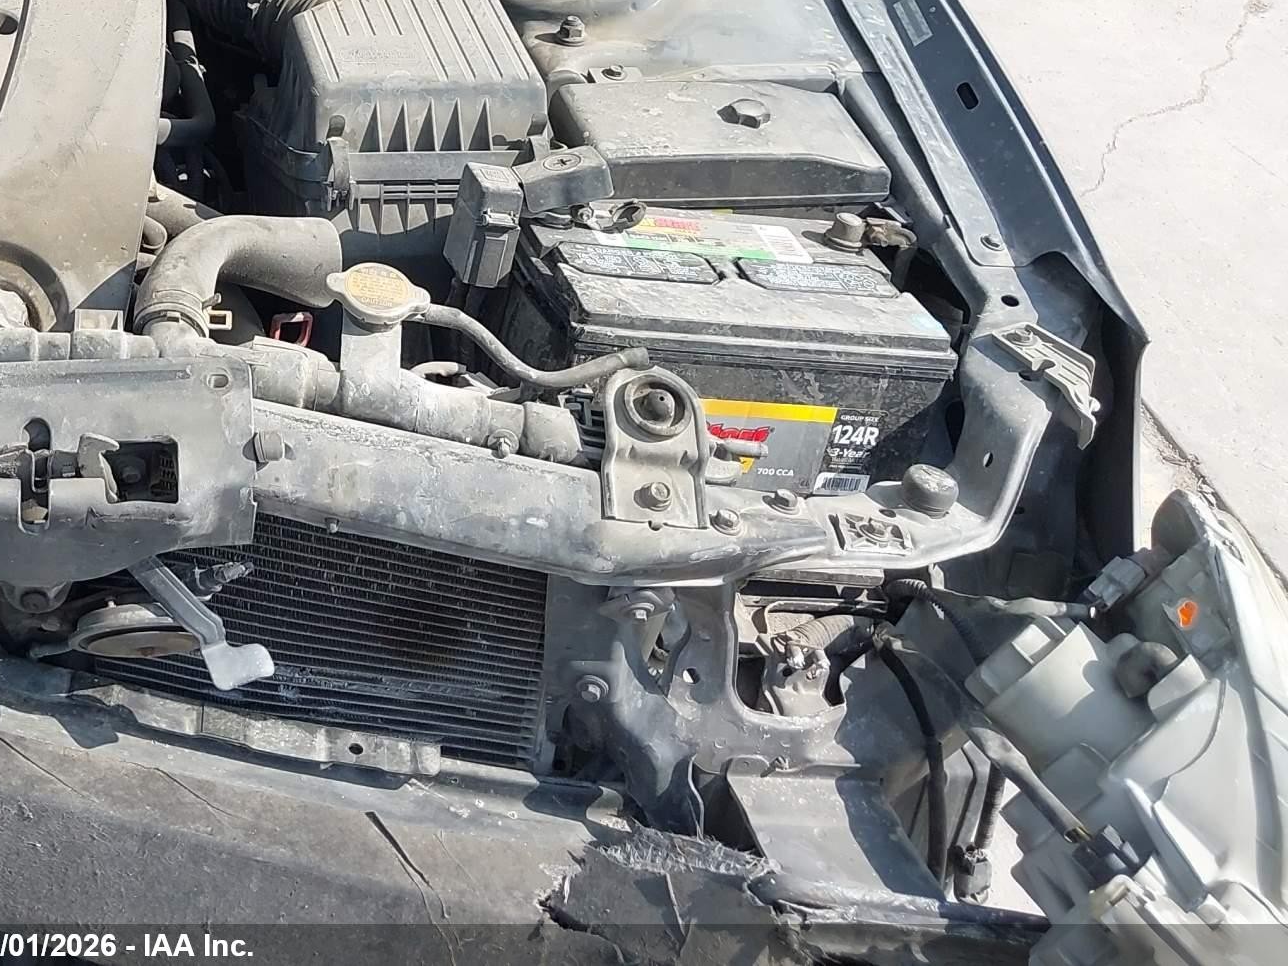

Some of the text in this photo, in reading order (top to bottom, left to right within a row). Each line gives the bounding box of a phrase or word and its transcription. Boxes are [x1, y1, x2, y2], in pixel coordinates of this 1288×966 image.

[840, 414, 864, 422] GROUP
[832, 424, 880, 447] 124R
[829, 447, 870, 459] 3-Year
[757, 467, 794, 476] 700 CCA
